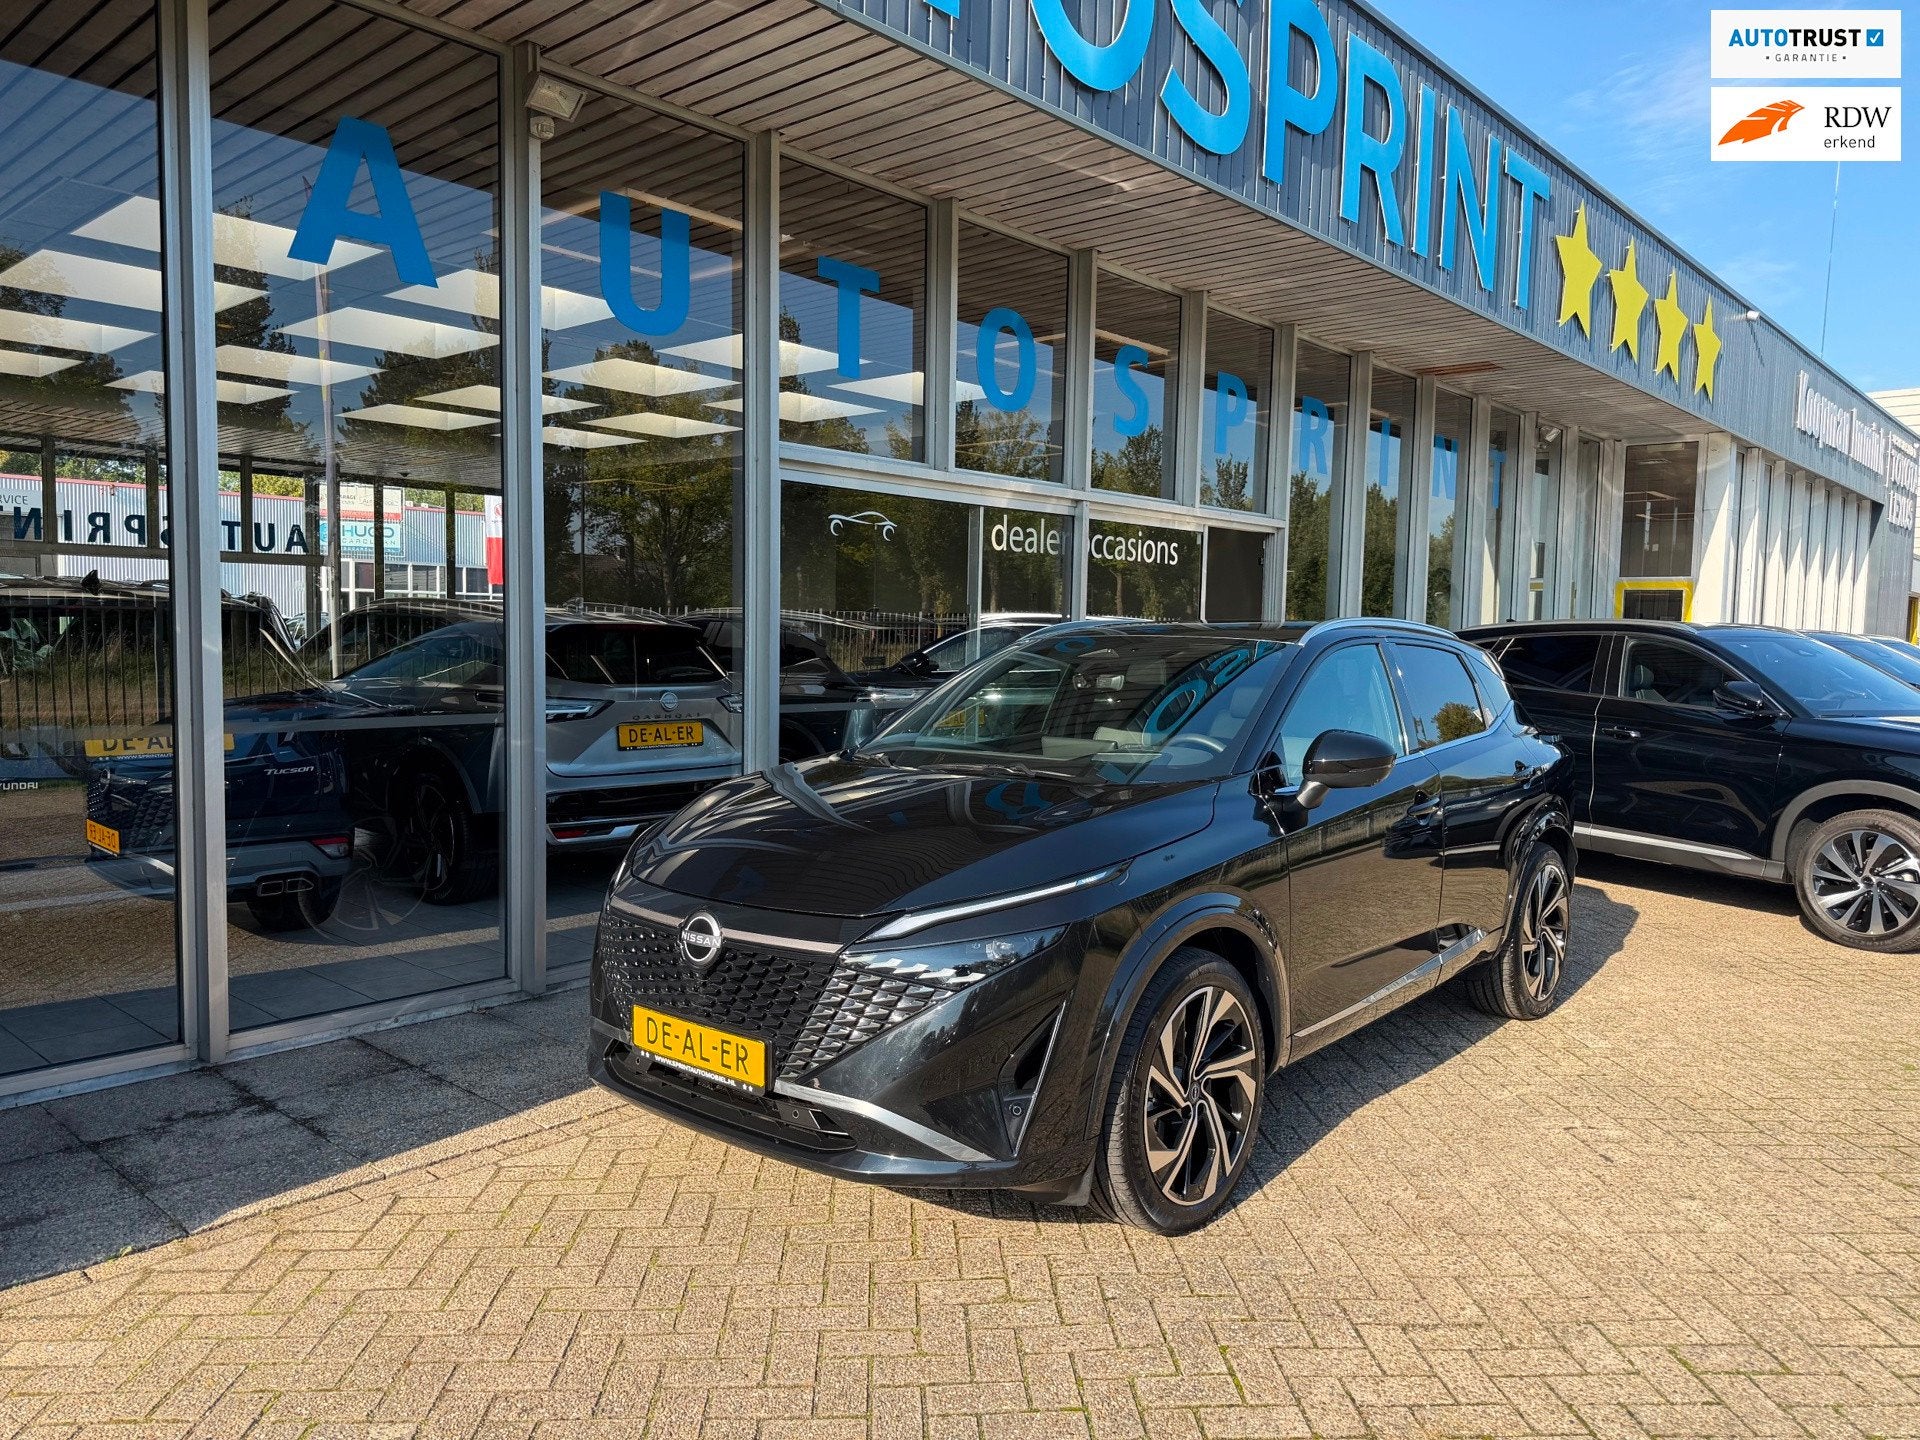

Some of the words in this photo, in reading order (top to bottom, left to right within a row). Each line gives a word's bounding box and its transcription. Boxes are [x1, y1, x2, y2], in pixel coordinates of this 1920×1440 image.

[923, 0, 1550, 311] SPRINT
[1088, 530, 1179, 566] ccasions
[629, 725, 694, 743] DE-AL-ER
[682, 931, 721, 948] NISSAN
[646, 1016, 749, 1075] DE-AL-ER
